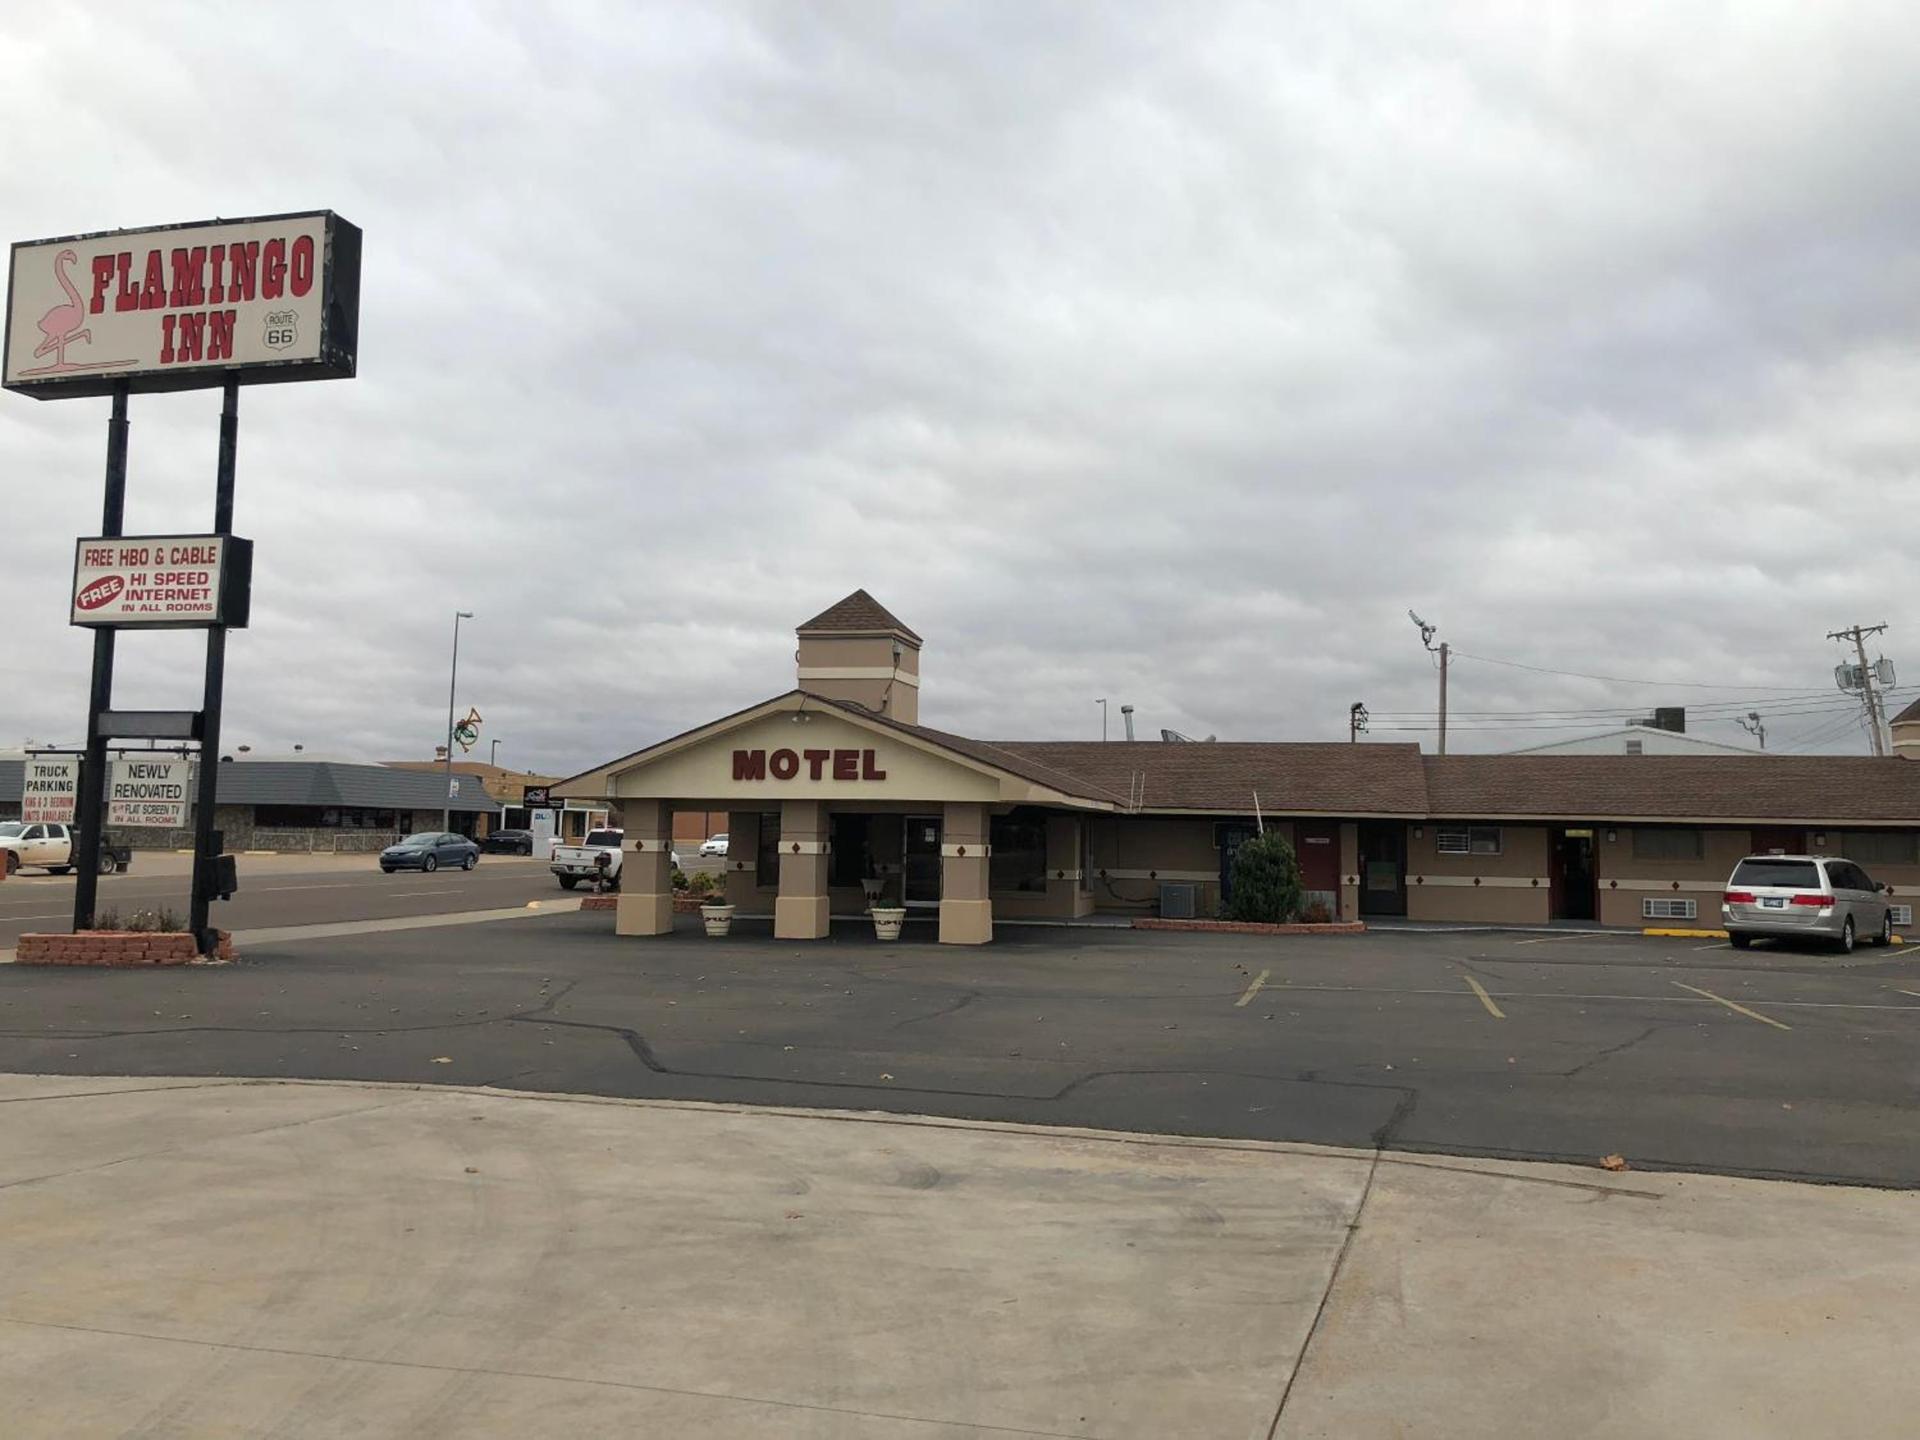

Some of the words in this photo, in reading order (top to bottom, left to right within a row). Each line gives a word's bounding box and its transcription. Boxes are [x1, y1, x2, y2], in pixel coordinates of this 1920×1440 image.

[90, 235, 314, 313] FLAMINGO
[269, 314, 293, 325] ROUTE
[160, 310, 237, 364] INN
[268, 329, 293, 344] 66
[85, 549, 113, 567] FREE
[119, 548, 149, 567] HBO
[154, 547, 165, 565] &
[171, 546, 217, 565] CABLE
[130, 573, 147, 586] HI
[154, 572, 209, 586] SPEED
[80, 578, 122, 607] FREE
[125, 588, 211, 601] INTERNET
[121, 604, 134, 612] IN
[139, 603, 161, 612] ALL
[166, 603, 213, 612] ROOMS
[34, 765, 69, 777] TRUCK
[128, 764, 171, 779] NEWLY
[732, 748, 887, 781] MOTEL
[26, 780, 73, 792] PARKING
[114, 783, 182, 799] RENOVATED
[125, 803, 140, 814] FLAT
[142, 804, 169, 815] SCREEN
[171, 804, 180, 815] TV
[114, 815, 124, 823] IN
[126, 815, 142, 824] ALL
[145, 815, 177, 824] ROOMS
